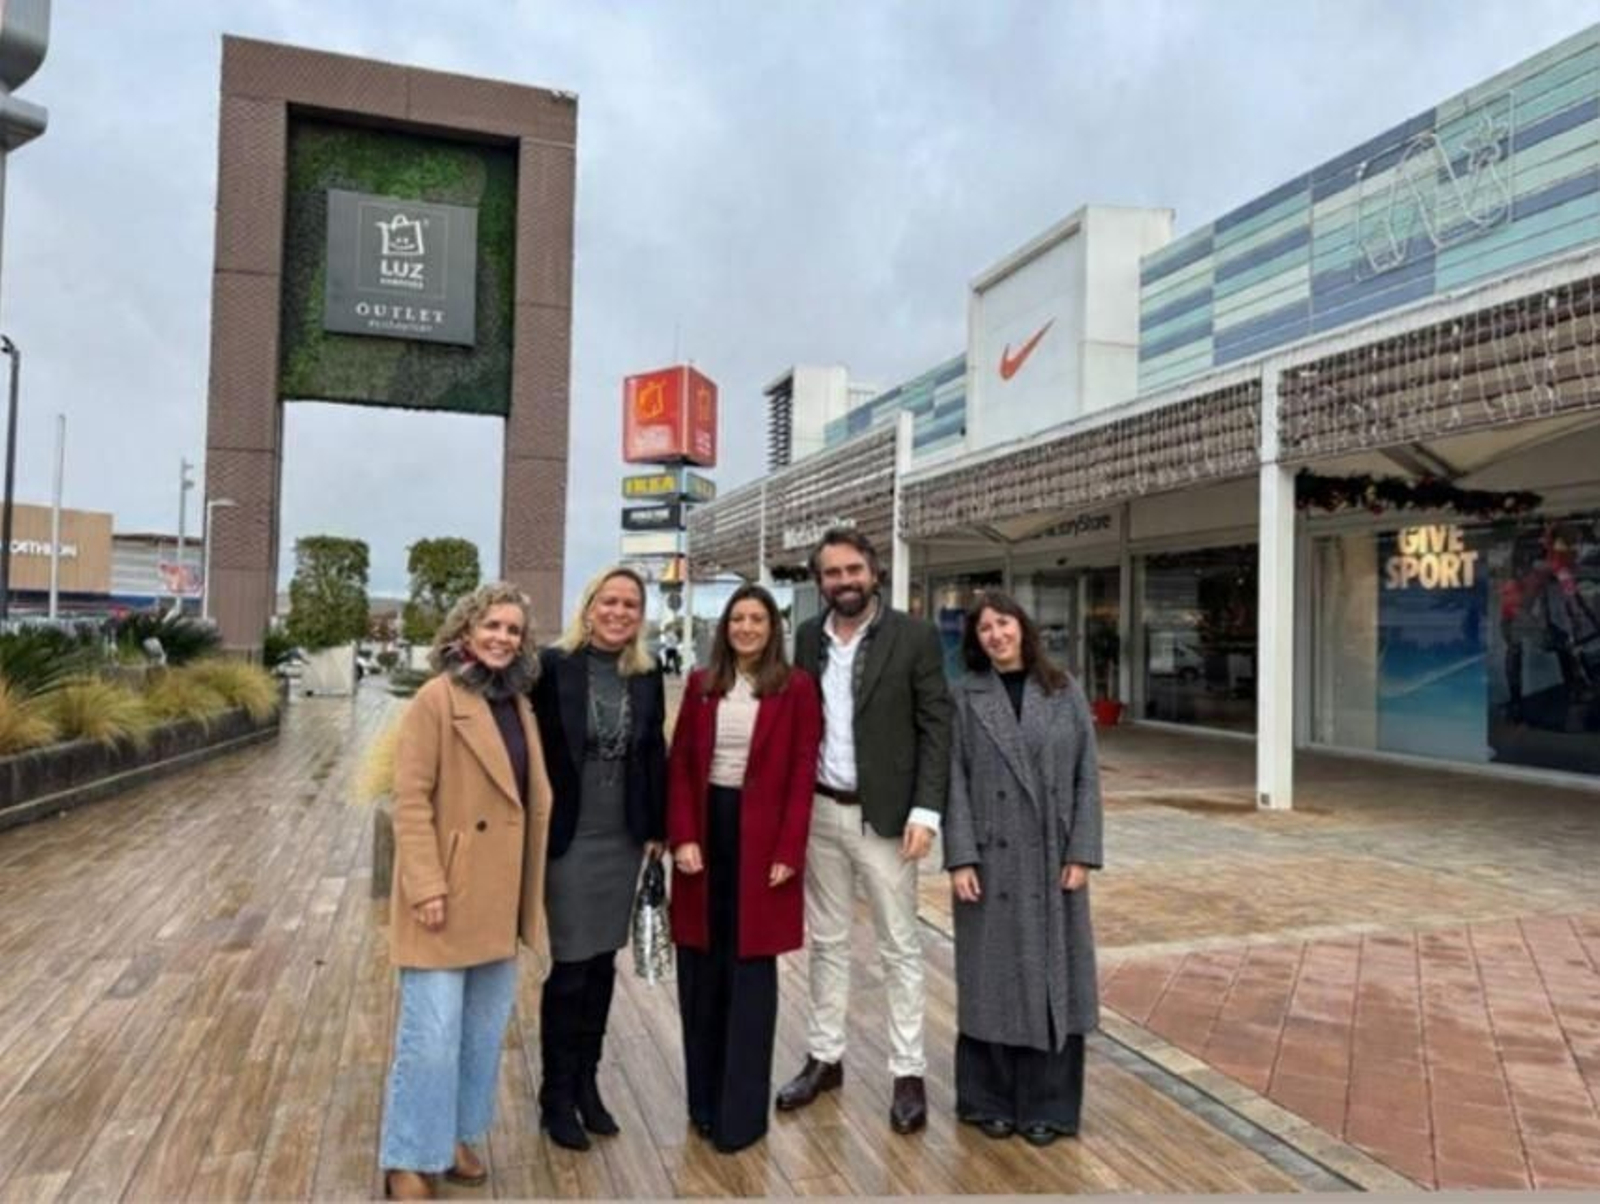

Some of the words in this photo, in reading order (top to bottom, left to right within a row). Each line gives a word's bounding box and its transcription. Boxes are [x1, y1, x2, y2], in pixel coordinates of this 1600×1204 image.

[380, 259, 424, 279] LUZ
[356, 301, 445, 323] OUTLET
[1399, 524, 1464, 554] GIVE
[1385, 552, 1478, 590] SPORT
